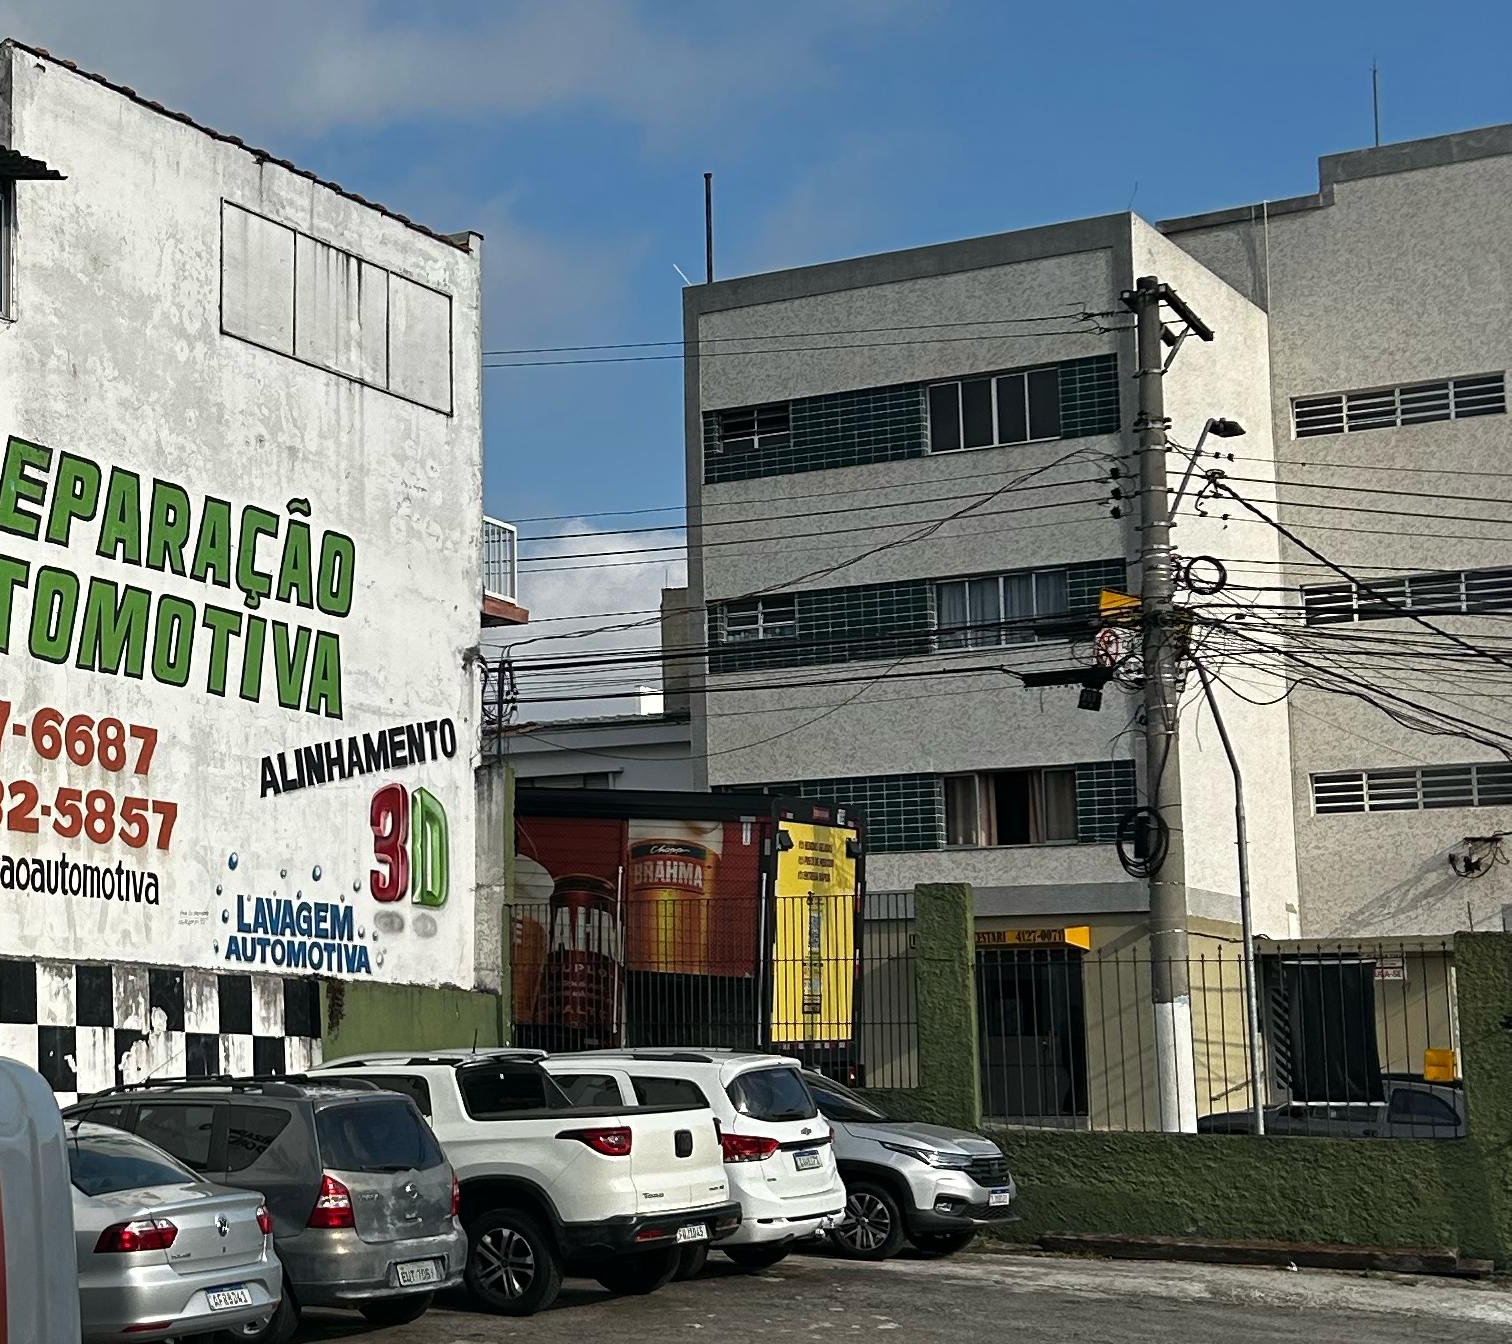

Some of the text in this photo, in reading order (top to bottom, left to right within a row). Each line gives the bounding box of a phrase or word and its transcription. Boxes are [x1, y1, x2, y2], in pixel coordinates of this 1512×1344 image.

[260, 718, 457, 798] ALINHAMENTO
[370, 783, 449, 911] 3D
[634, 860, 703, 888] BRAHMA
[237, 894, 354, 942] LAVAGEM
[225, 936, 371, 975] AUTOMOTIVA
